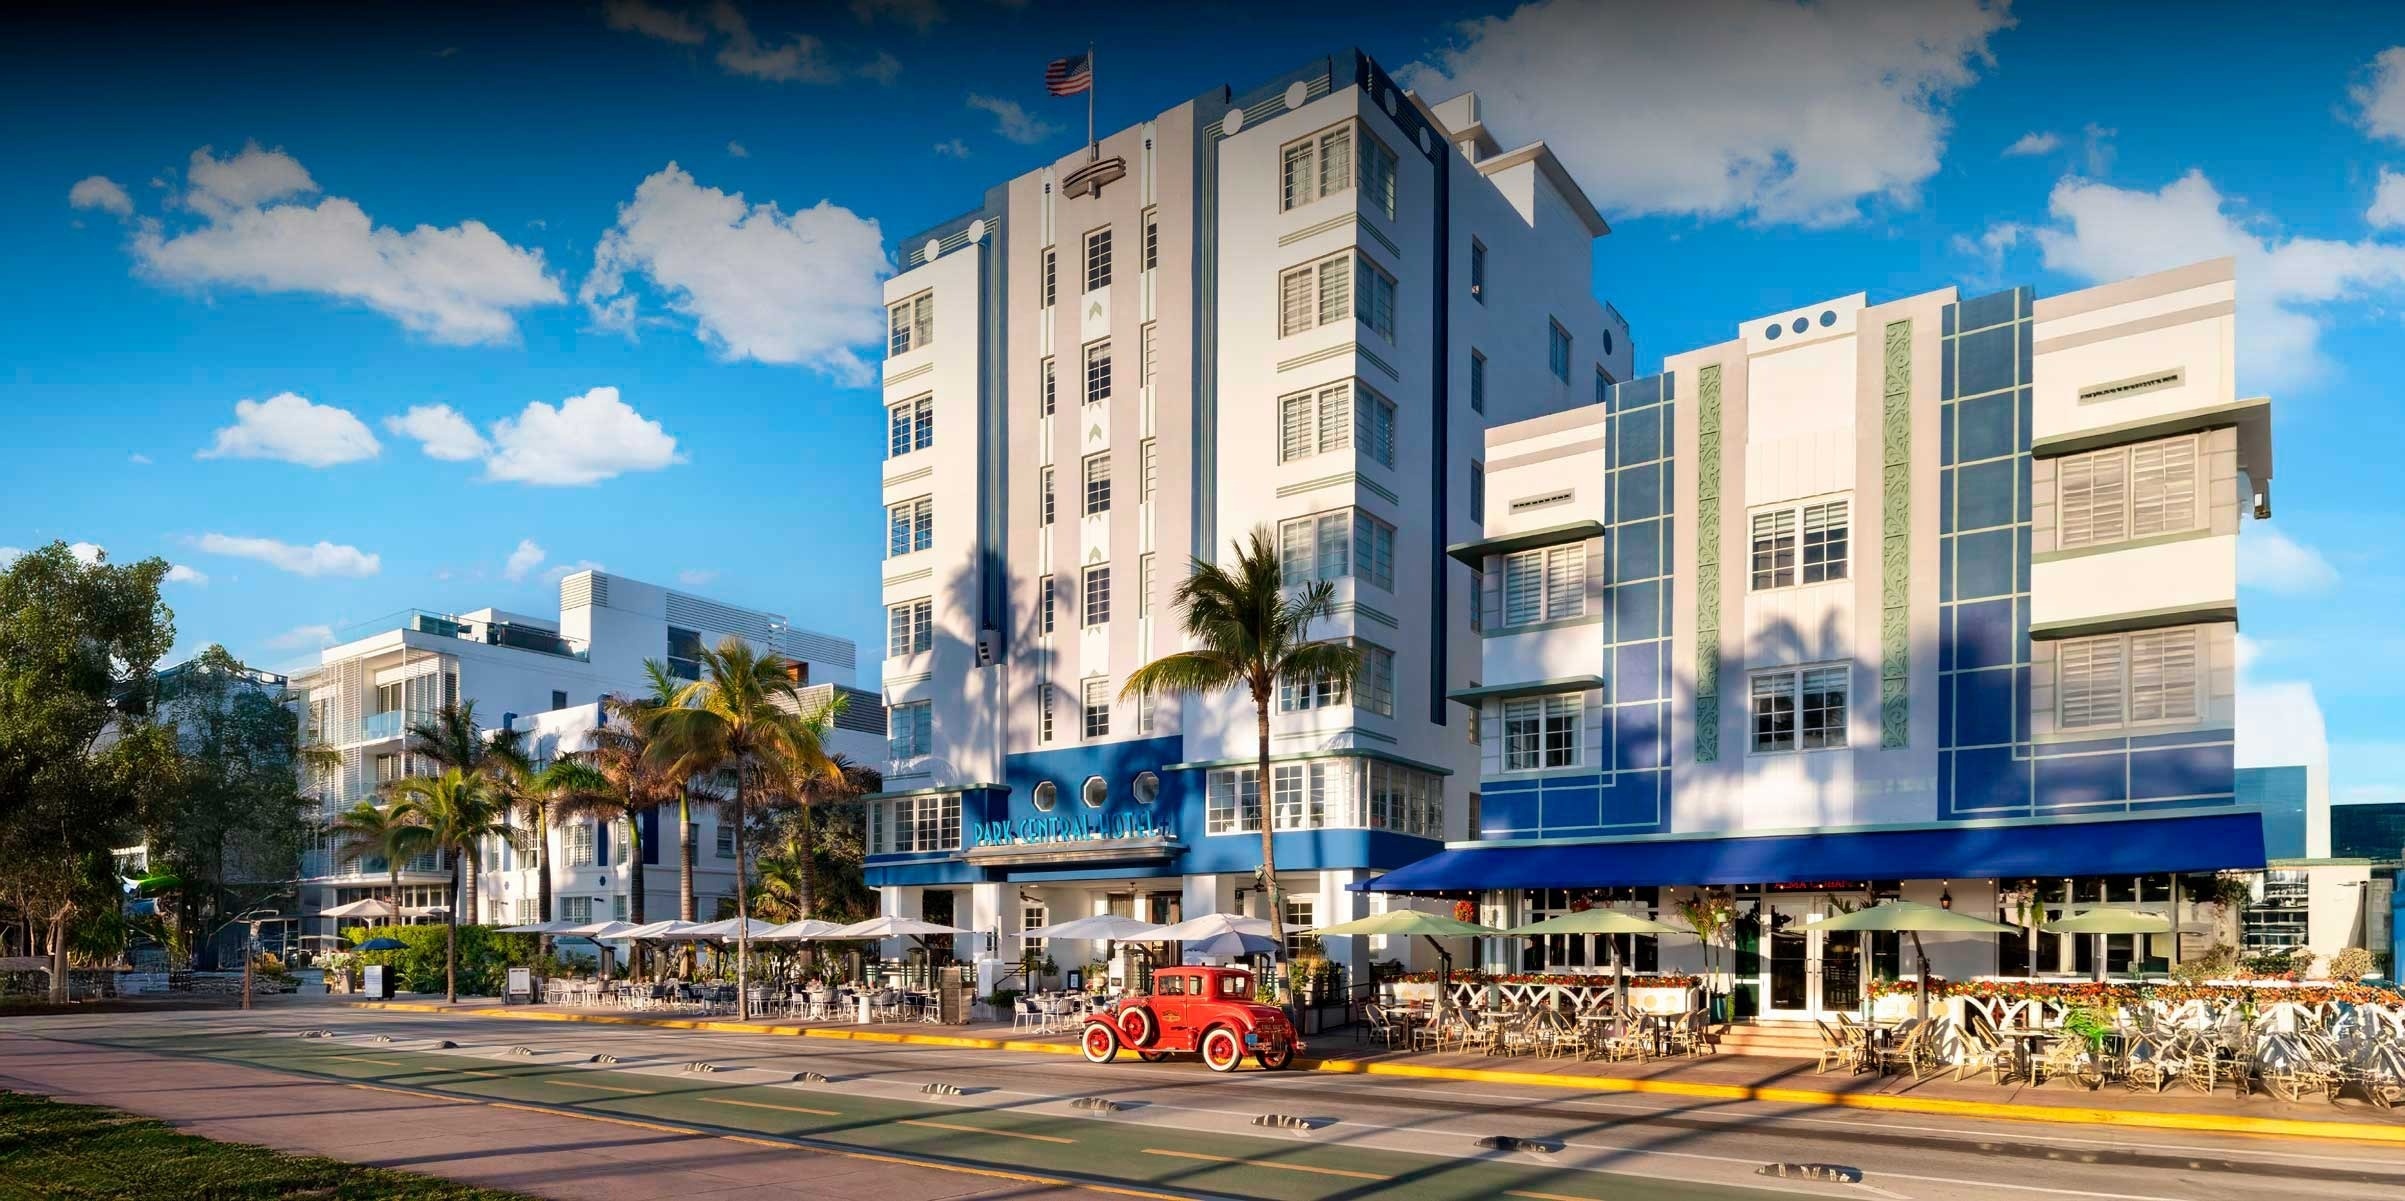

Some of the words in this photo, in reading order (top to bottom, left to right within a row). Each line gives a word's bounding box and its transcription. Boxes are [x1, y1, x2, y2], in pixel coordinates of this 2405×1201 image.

[974, 820, 1012, 846] PARK
[1020, 814, 1091, 843] CENTRAL
[1100, 809, 1156, 839] HOTEL
